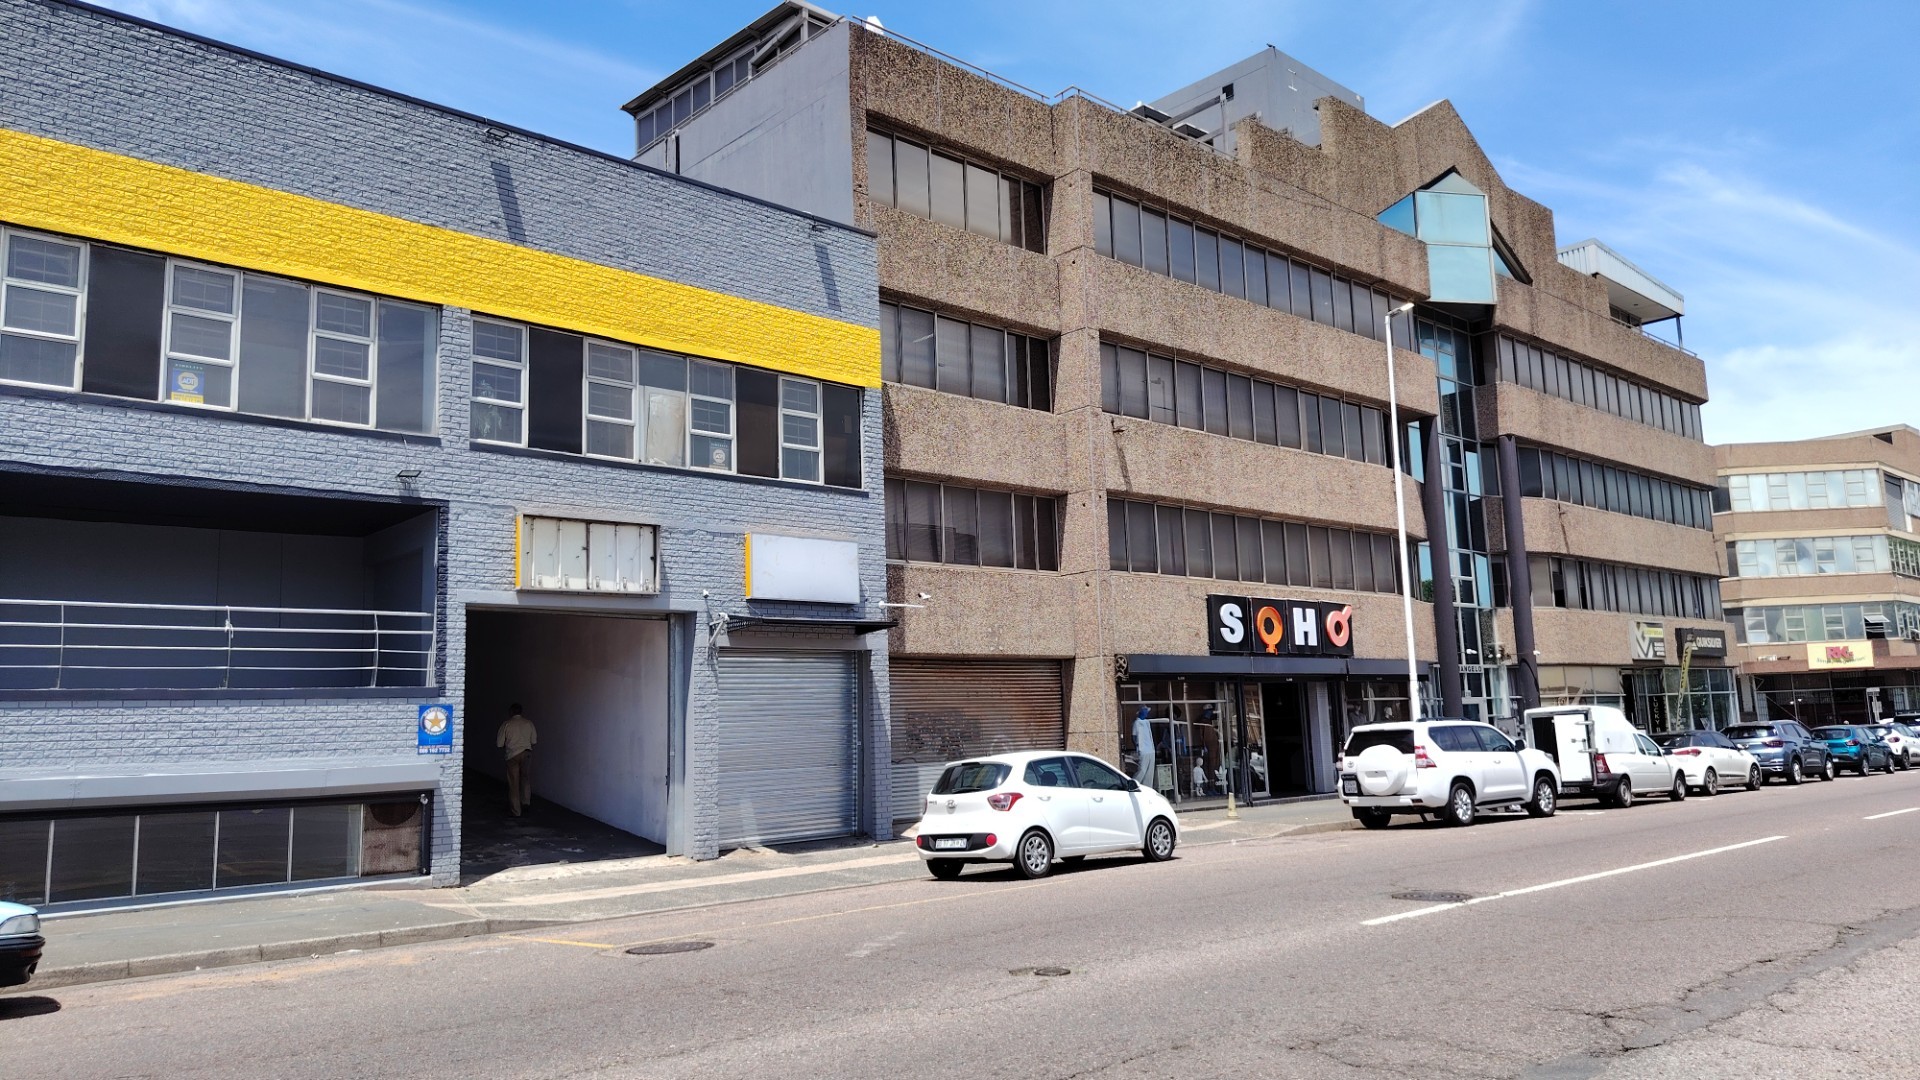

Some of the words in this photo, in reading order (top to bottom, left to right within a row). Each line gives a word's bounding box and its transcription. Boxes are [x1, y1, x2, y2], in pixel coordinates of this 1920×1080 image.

[182, 377, 195, 385] ADT
[1219, 603, 1352, 655] SOHO
[1696, 637, 1722, 648] QUIKSILVER
